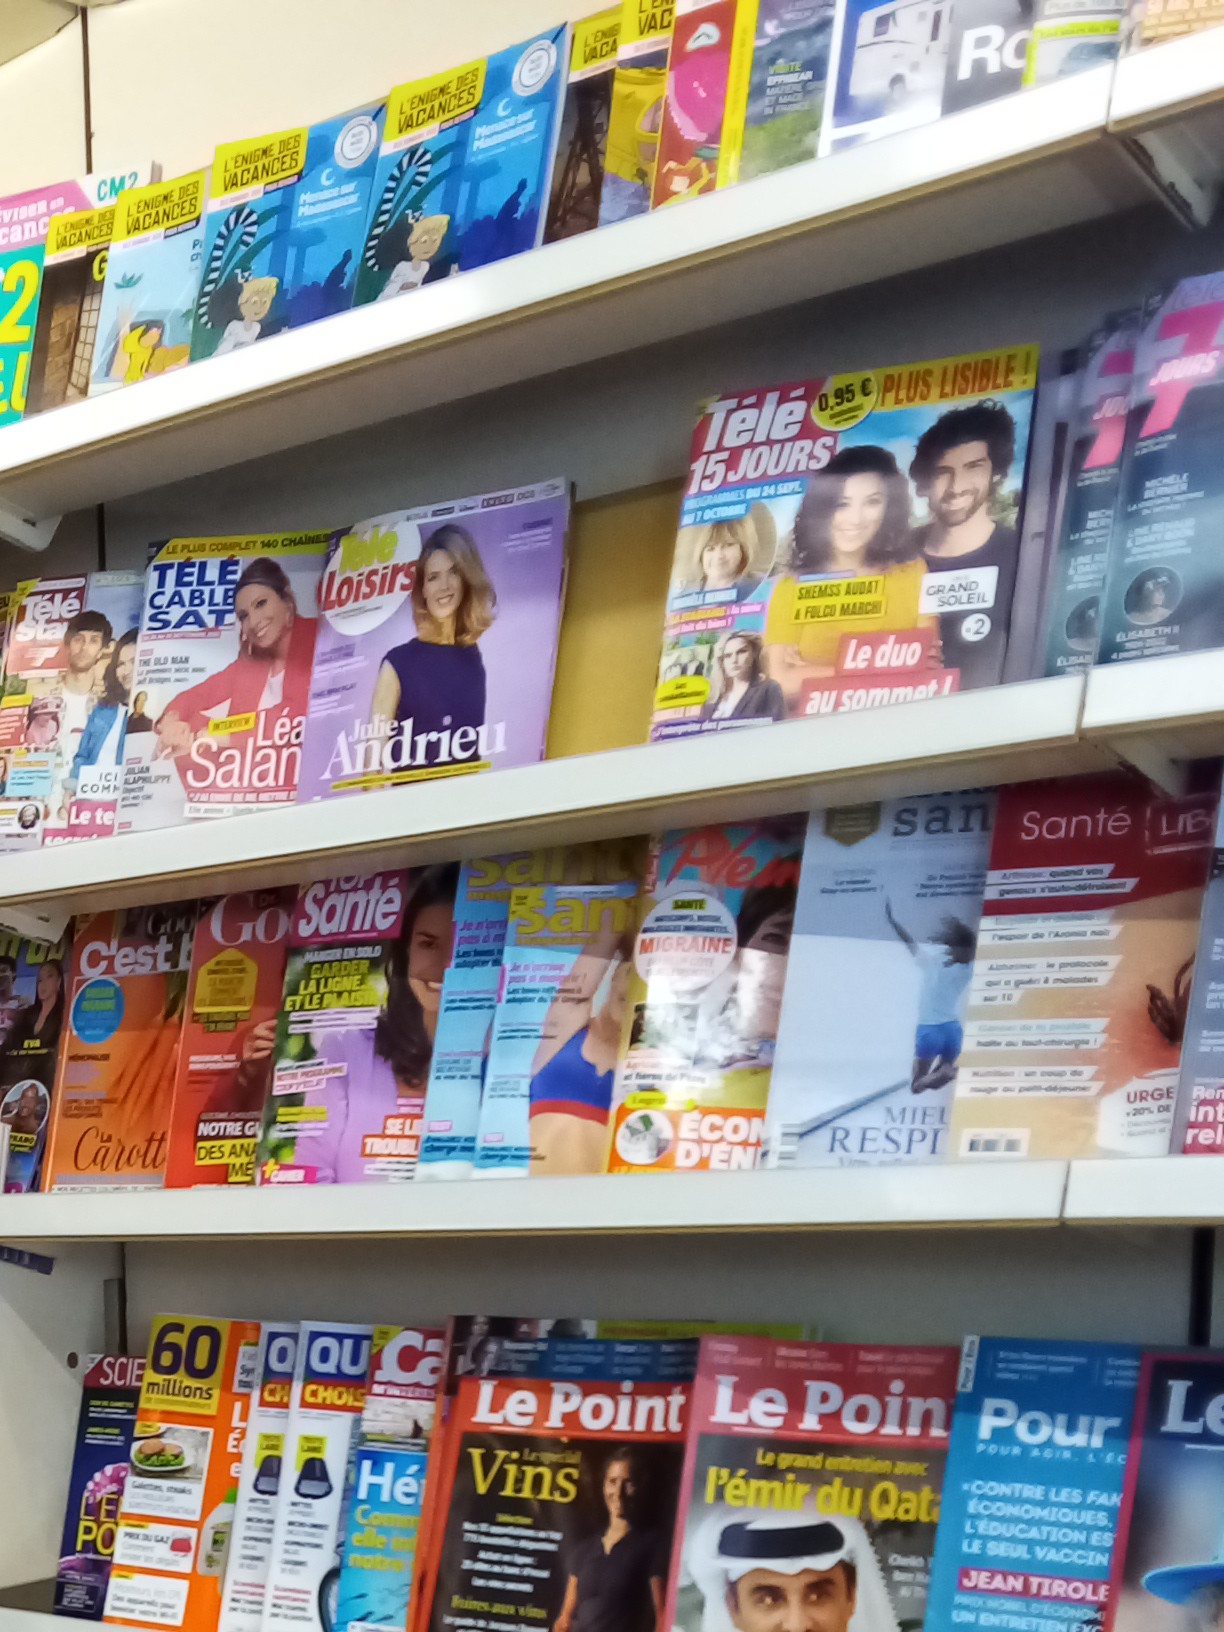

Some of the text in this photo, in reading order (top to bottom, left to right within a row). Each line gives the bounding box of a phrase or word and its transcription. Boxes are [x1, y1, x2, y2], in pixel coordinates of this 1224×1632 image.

[880, 354, 1016, 407] PLUS LISIBLE
[700, 387, 807, 452] Télé
[727, 436, 835, 482] JOURS
[151, 555, 239, 588] TÉLÉ
[322, 559, 419, 612] Loisirs
[926, 580, 979, 597] GRAND
[146, 608, 237, 632] SAT
[937, 591, 988, 608] SOLEIL
[843, 634, 922, 670] Le duo
[805, 689, 835, 715] au
[255, 707, 305, 748] Léa
[320, 718, 508, 780] Andrieu
[350, 714, 400, 740] Julie
[1020, 806, 1132, 841] Santé
[298, 881, 403, 939] Santé
[151, 1321, 221, 1378] 60
[146, 1377, 213, 1400] millions
[472, 1380, 686, 1434] Le Point
[710, 1376, 790, 1428] Le
[978, 1398, 1122, 1449] Pour
[466, 1447, 579, 1506] Vins
[704, 1465, 862, 1517] l'émir du
[962, 1571, 1024, 1593] JEAN
